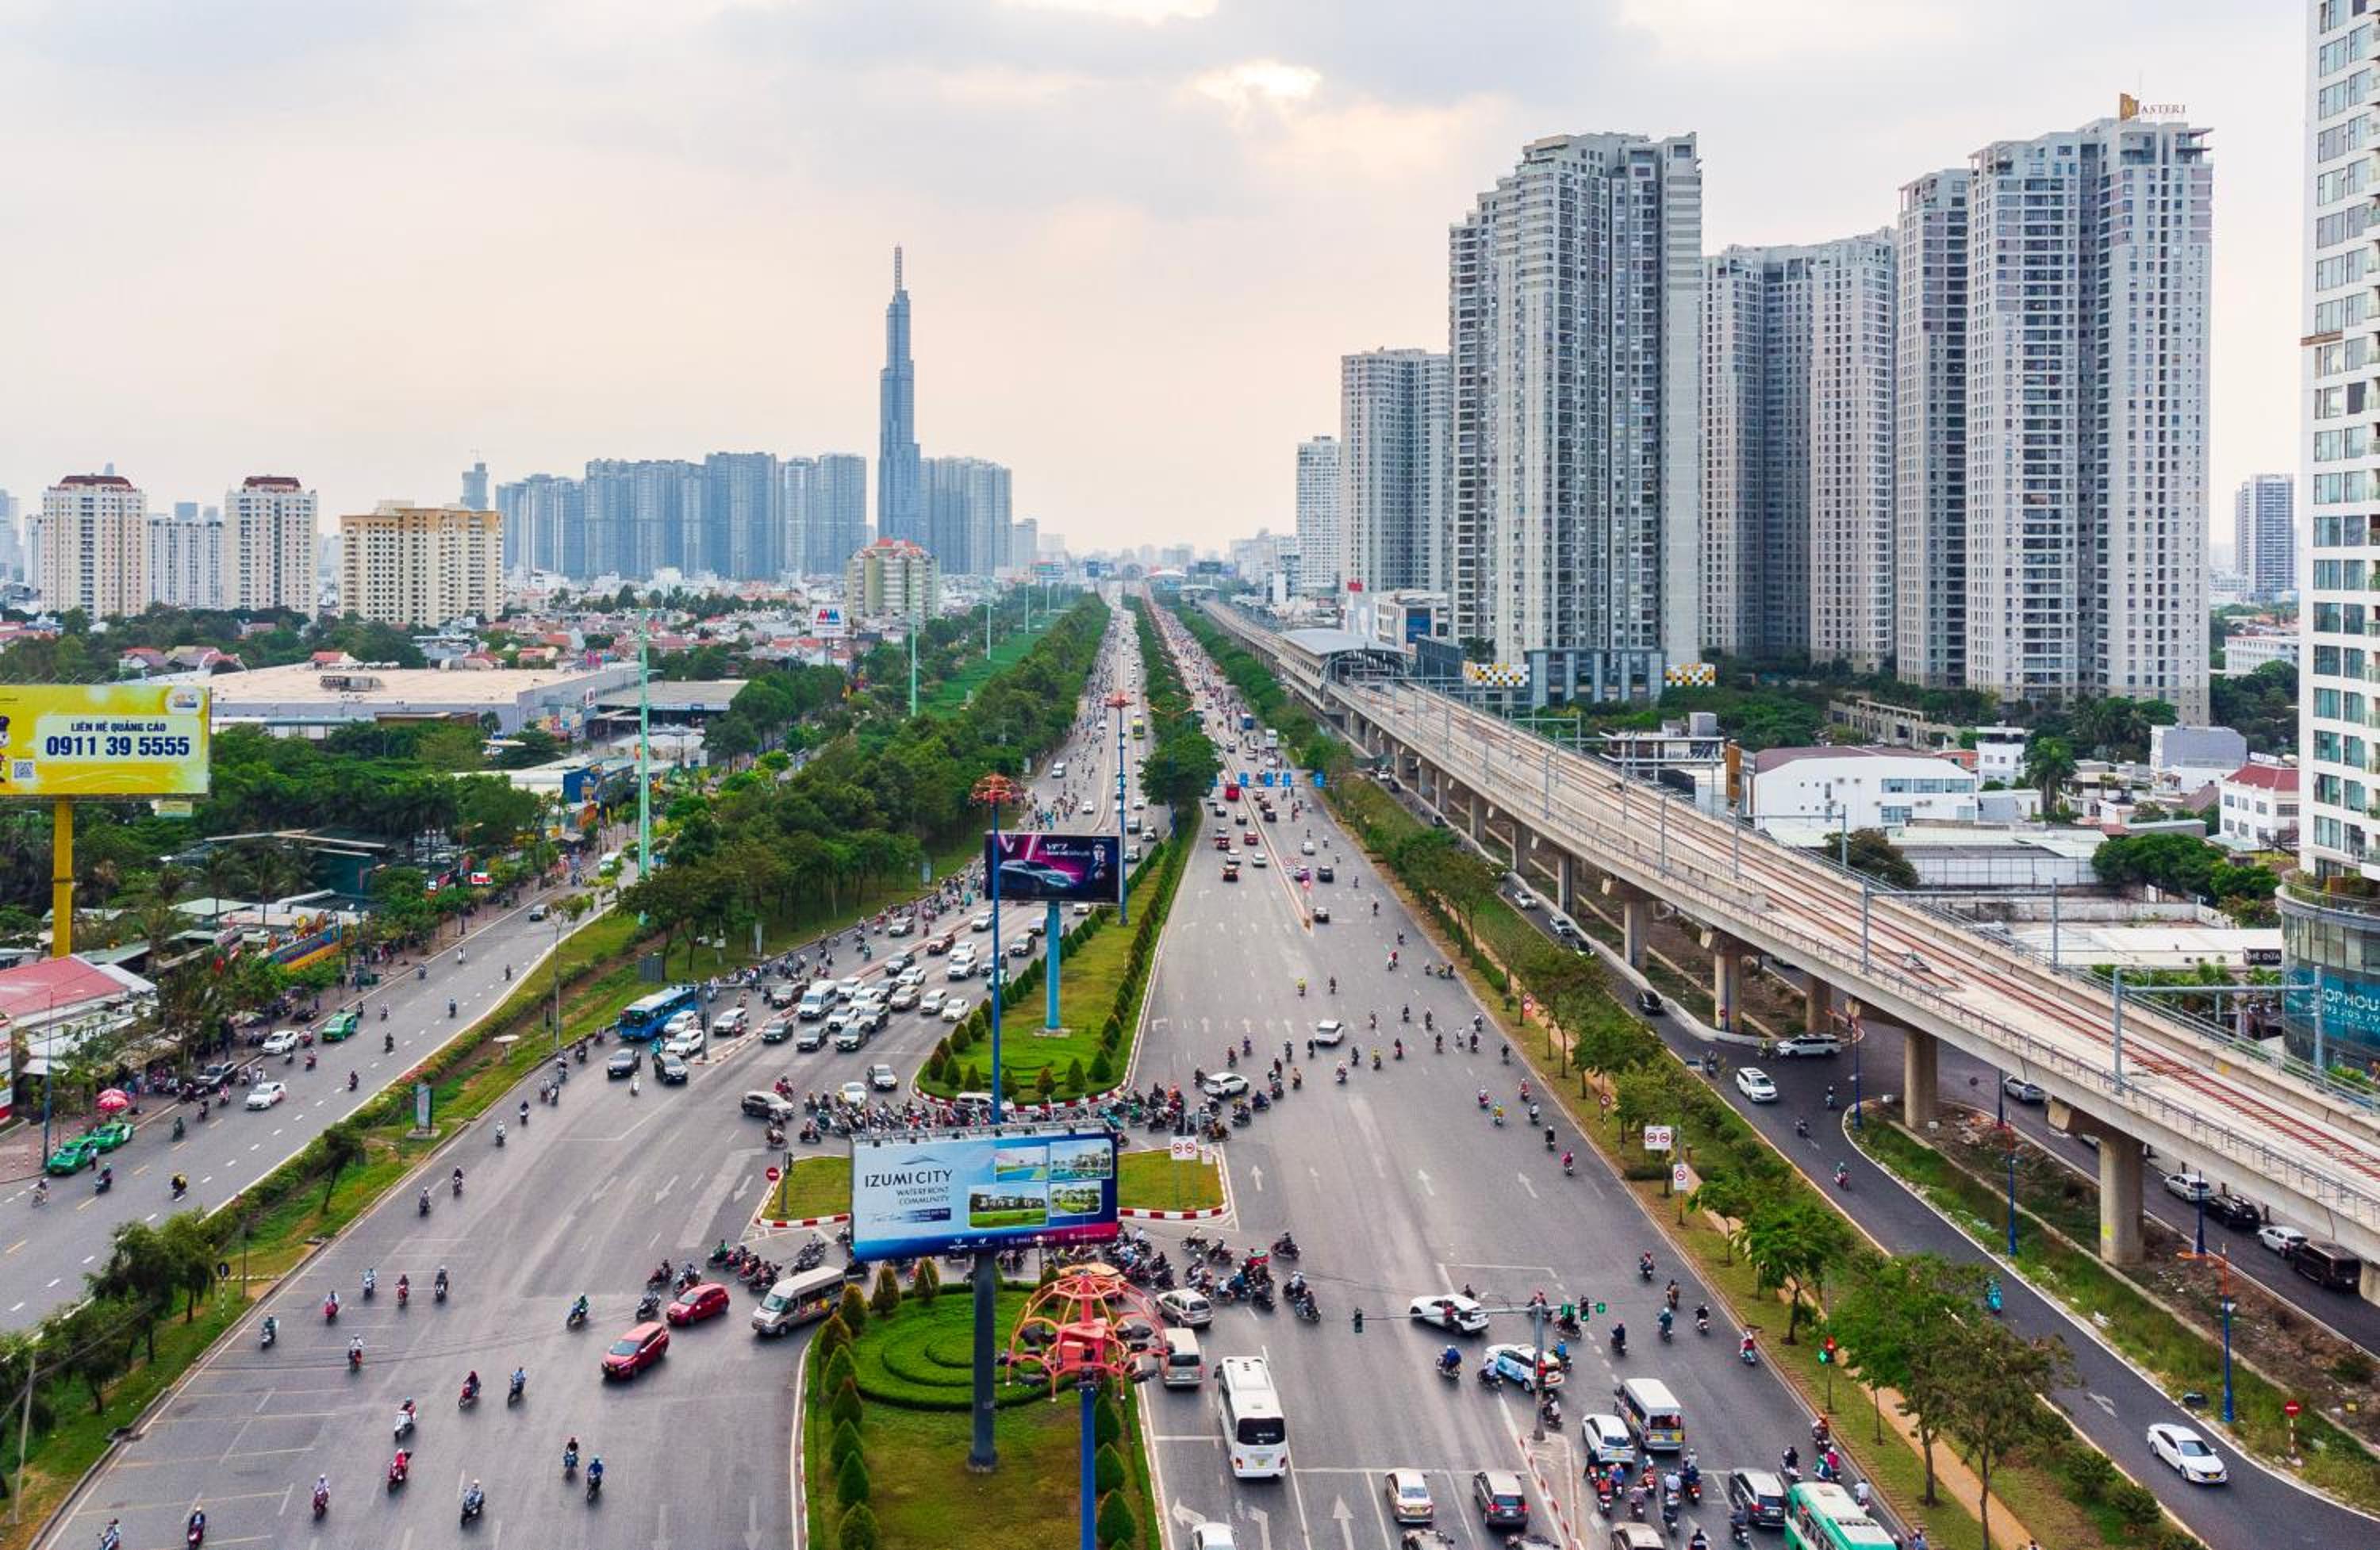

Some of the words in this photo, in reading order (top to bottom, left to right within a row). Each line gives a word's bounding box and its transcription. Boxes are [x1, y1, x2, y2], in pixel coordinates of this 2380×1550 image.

[71, 721, 93, 731] LIÊN
[95, 721, 108, 732] HỆ
[110, 720, 144, 733] QUẢNG
[147, 720, 167, 732] CÁO
[46, 735, 96, 755] 0911
[105, 735, 132, 756] 39
[138, 735, 190, 756] 5555
[865, 1172, 912, 1187] IZUMI
[916, 1168, 953, 1184] CITY
[899, 1195, 949, 1205] COMMUNITY
